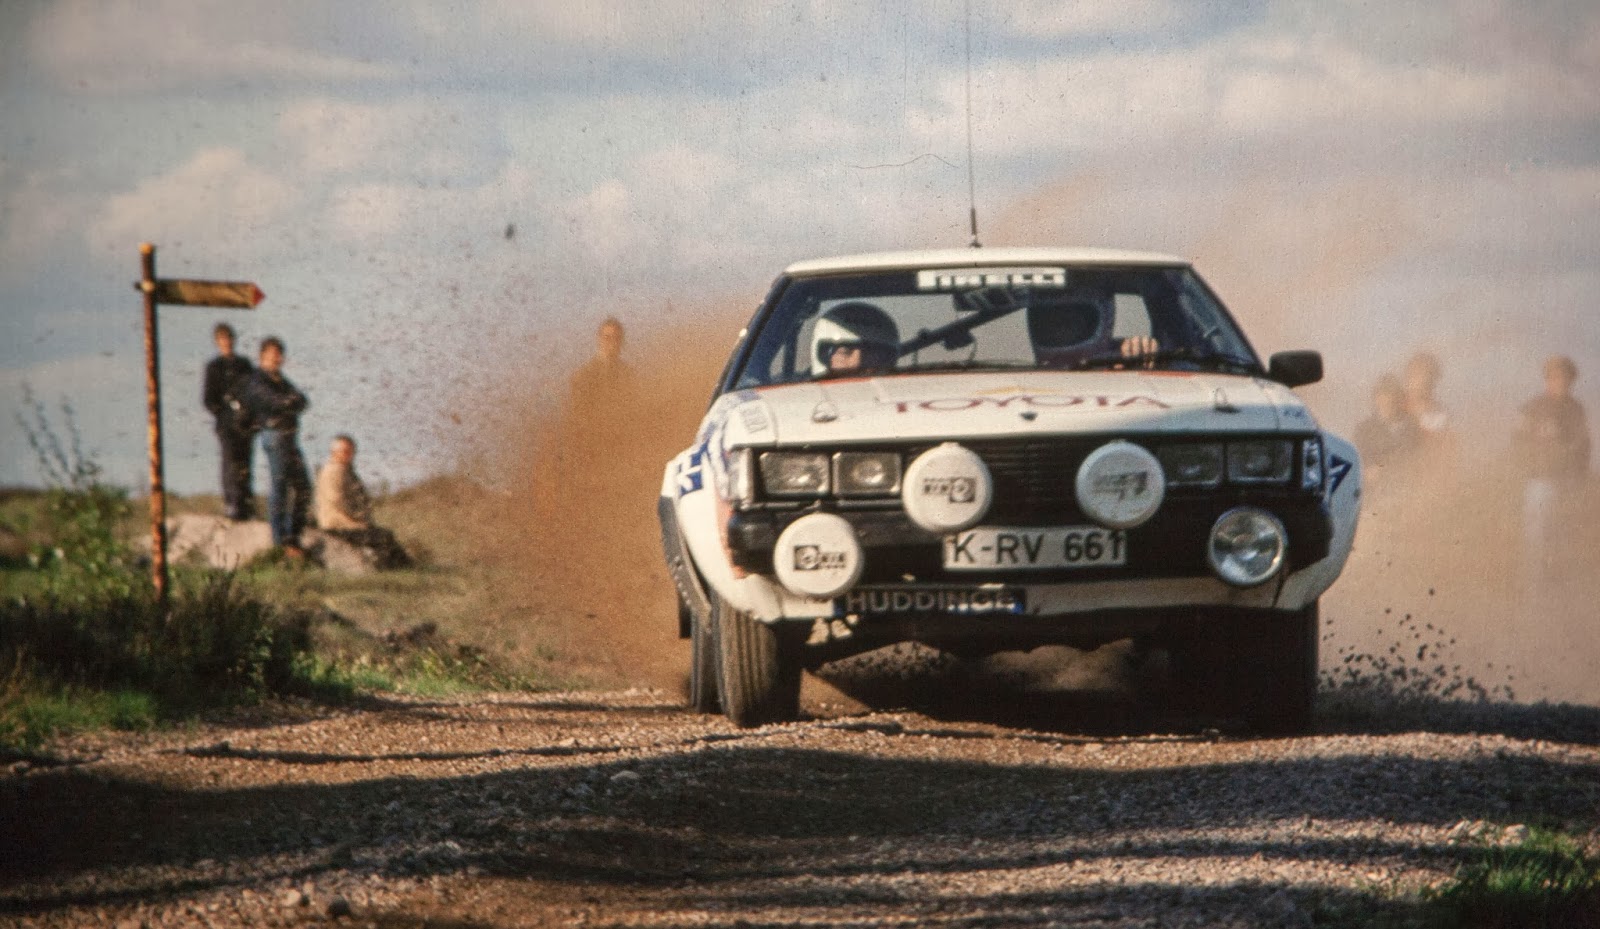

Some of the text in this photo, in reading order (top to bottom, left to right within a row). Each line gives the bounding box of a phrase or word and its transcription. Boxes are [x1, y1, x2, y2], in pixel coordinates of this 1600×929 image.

[885, 396, 1172, 413] TOYOTA
[952, 530, 1127, 564] K-RV 661
